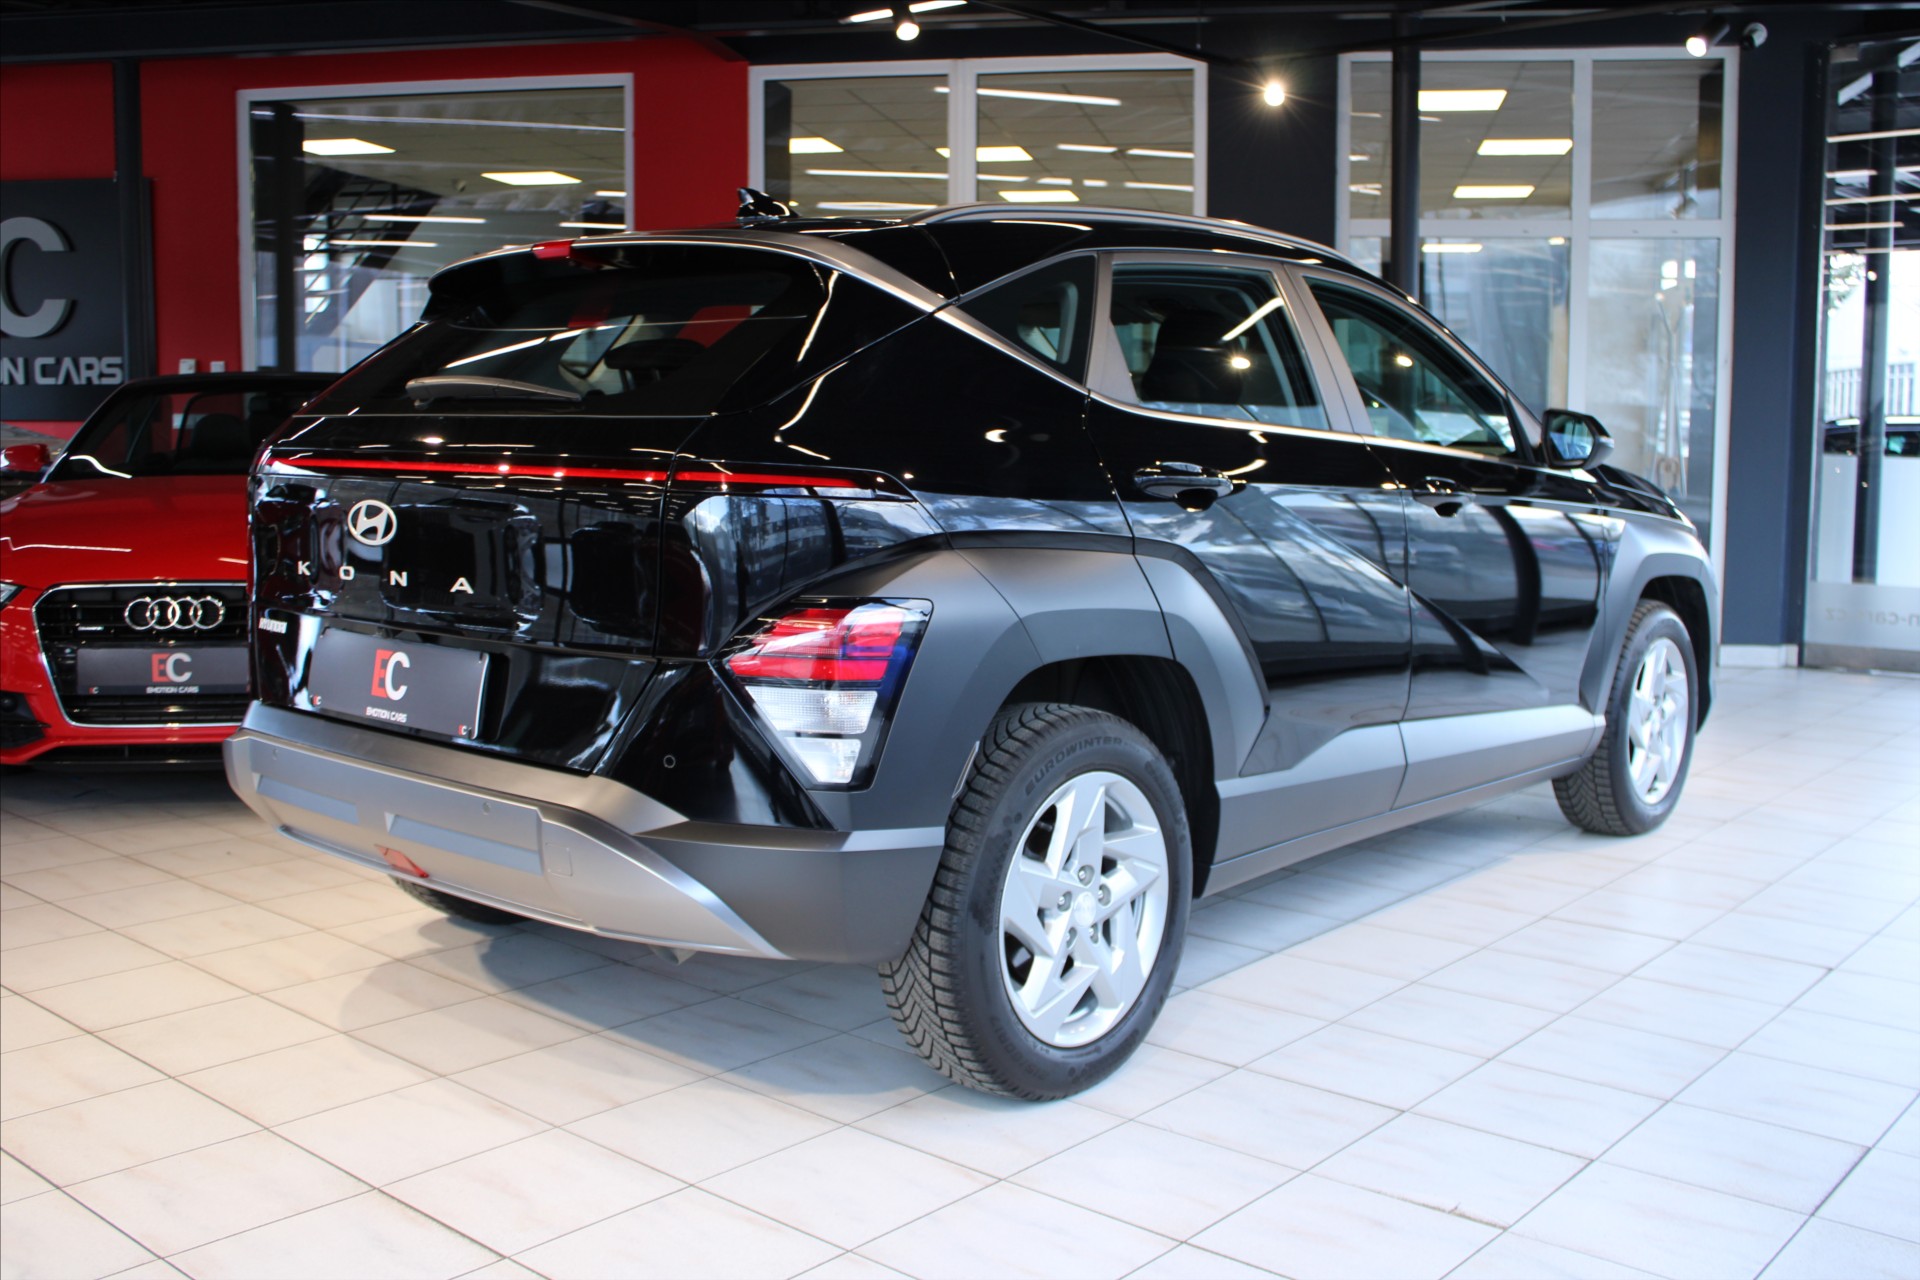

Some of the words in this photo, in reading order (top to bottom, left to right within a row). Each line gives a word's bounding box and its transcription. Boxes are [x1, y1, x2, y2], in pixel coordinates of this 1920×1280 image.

[34, 357, 123, 385] CARS
[297, 560, 474, 595] KONA
[151, 652, 192, 683] EC
[371, 648, 410, 701] EC
[390, 711, 408, 723] CARS
[1025, 735, 1123, 796] EUROWINTER
